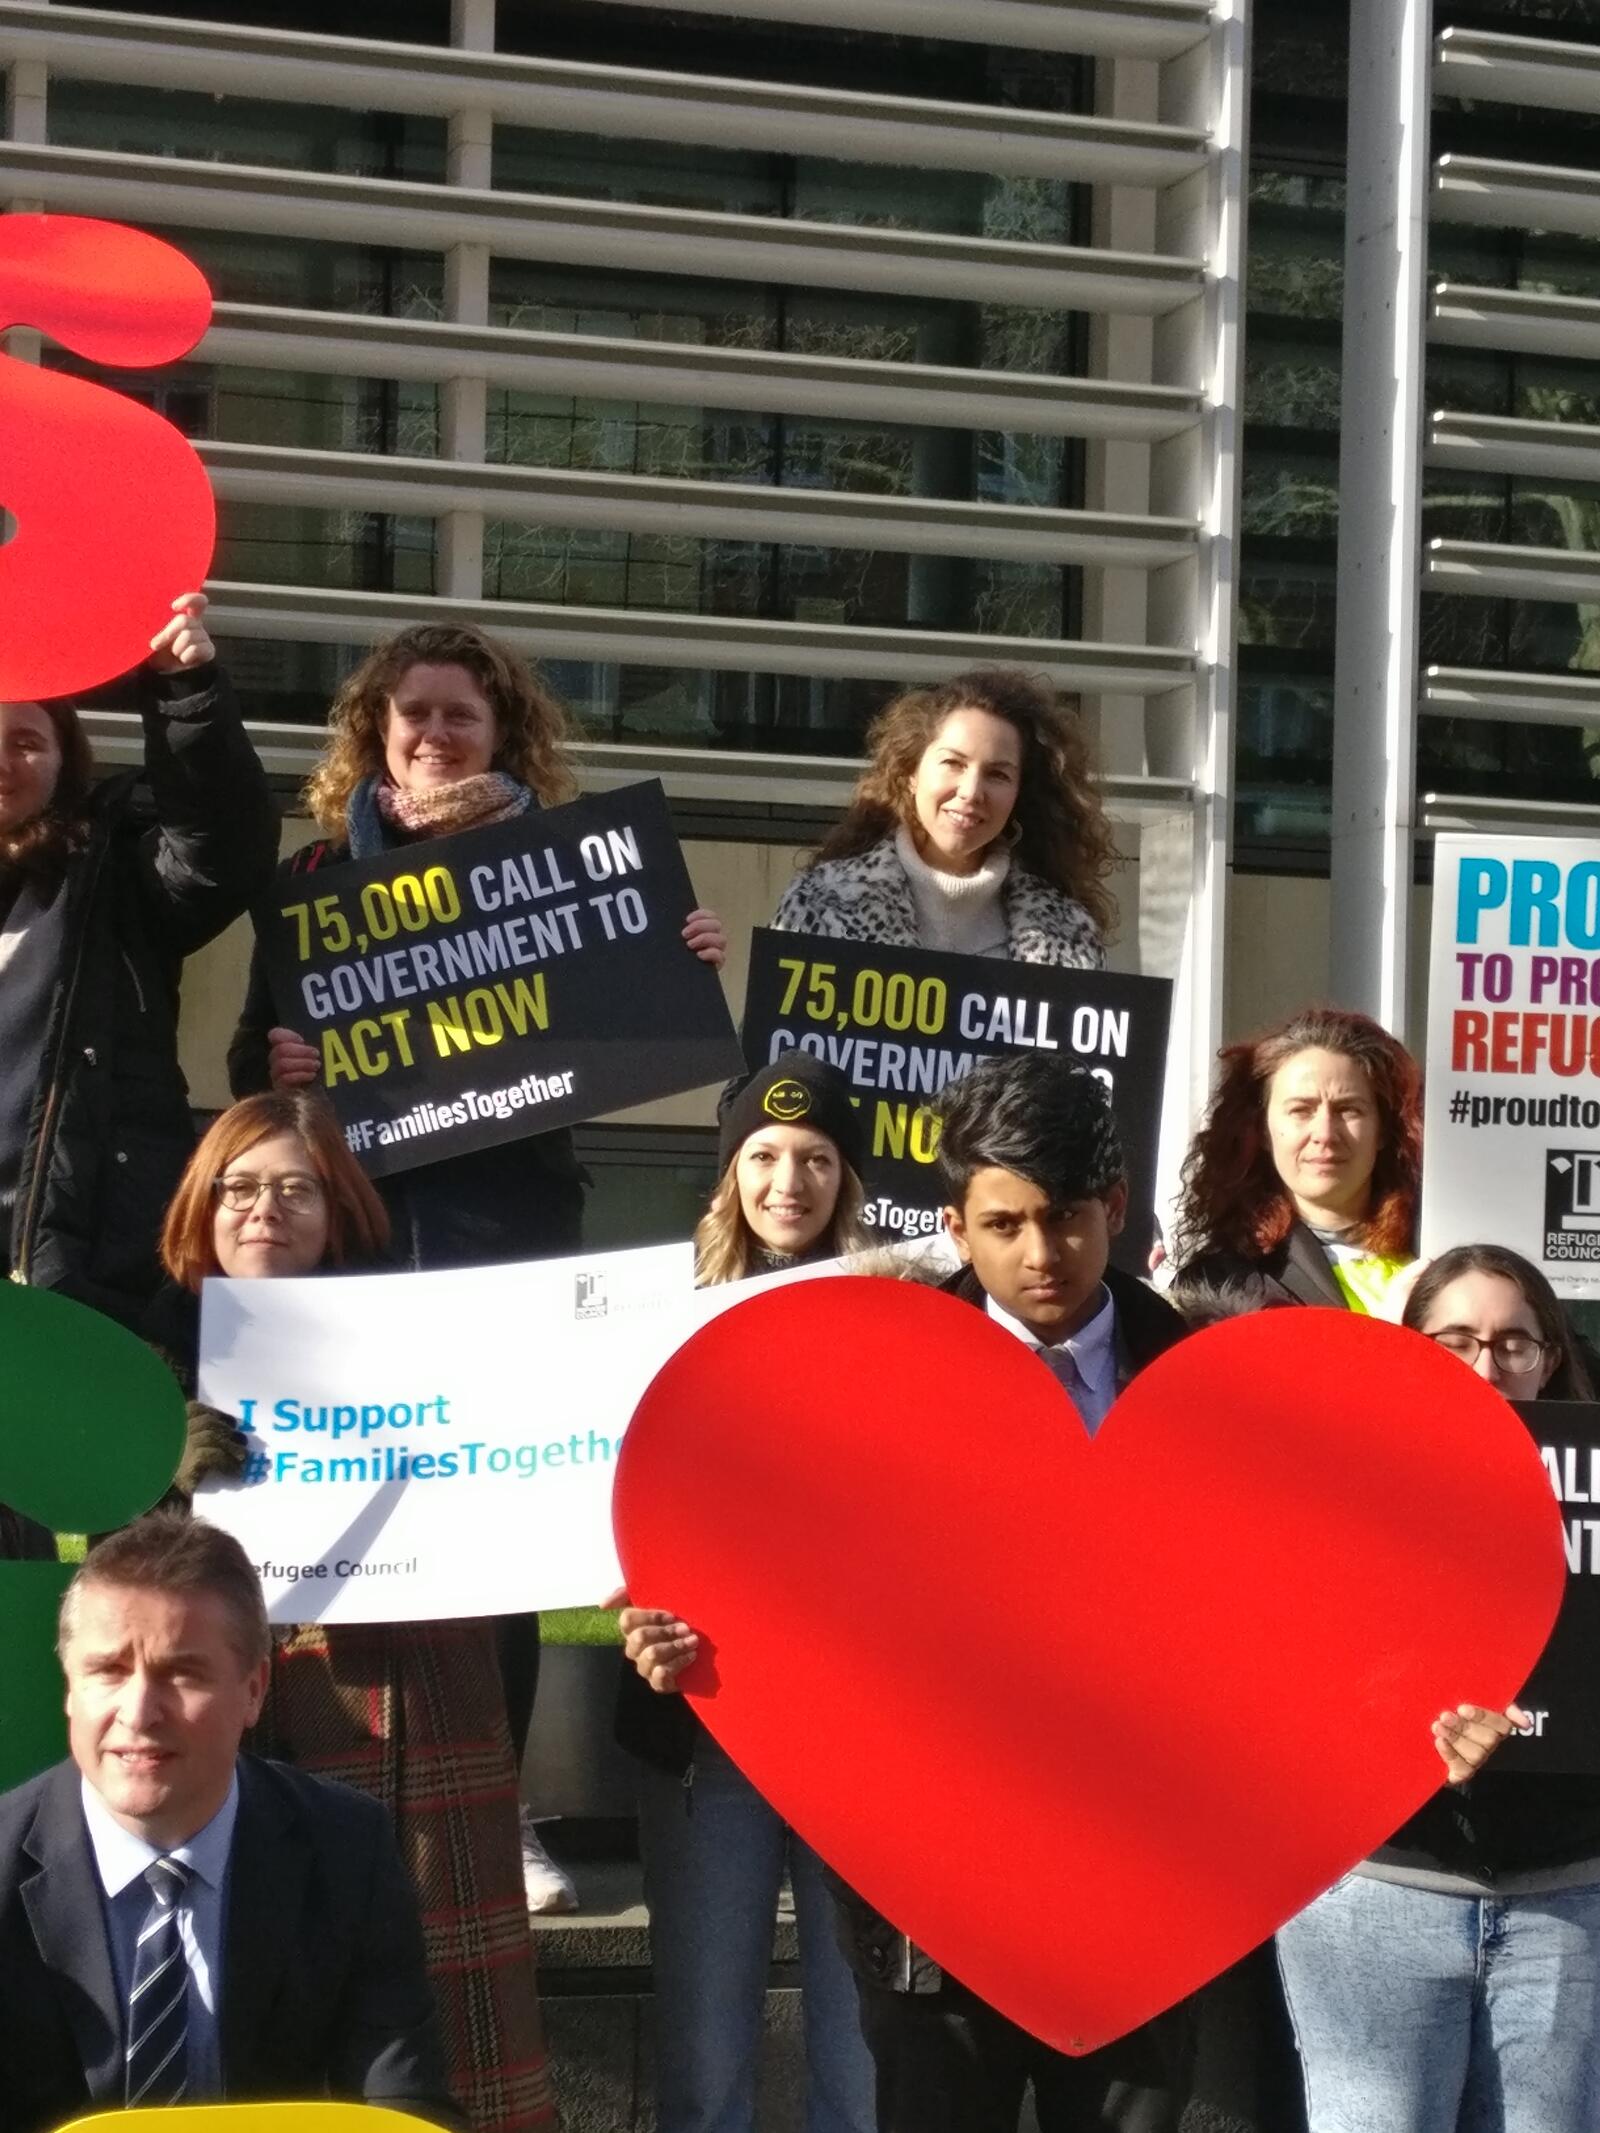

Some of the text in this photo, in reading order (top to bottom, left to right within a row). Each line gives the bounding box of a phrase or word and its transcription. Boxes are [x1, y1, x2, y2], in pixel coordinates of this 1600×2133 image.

[281, 826, 642, 961] 75,000 CALL ON
[301, 888, 648, 1019] GOVERNMENT TO
[1456, 953, 1512, 1003] TO
[320, 972, 550, 1087] ACT NOW
[777, 958, 1129, 1058] 75,000 CALL ON
[769, 1028, 998, 1094] GOVERNM
[345, 1070, 574, 1152] #FamiliesTogether
[873, 1100, 943, 1164] NO
[238, 1394, 451, 1439] I Support
[252, 1557, 417, 1583] efugee Council
